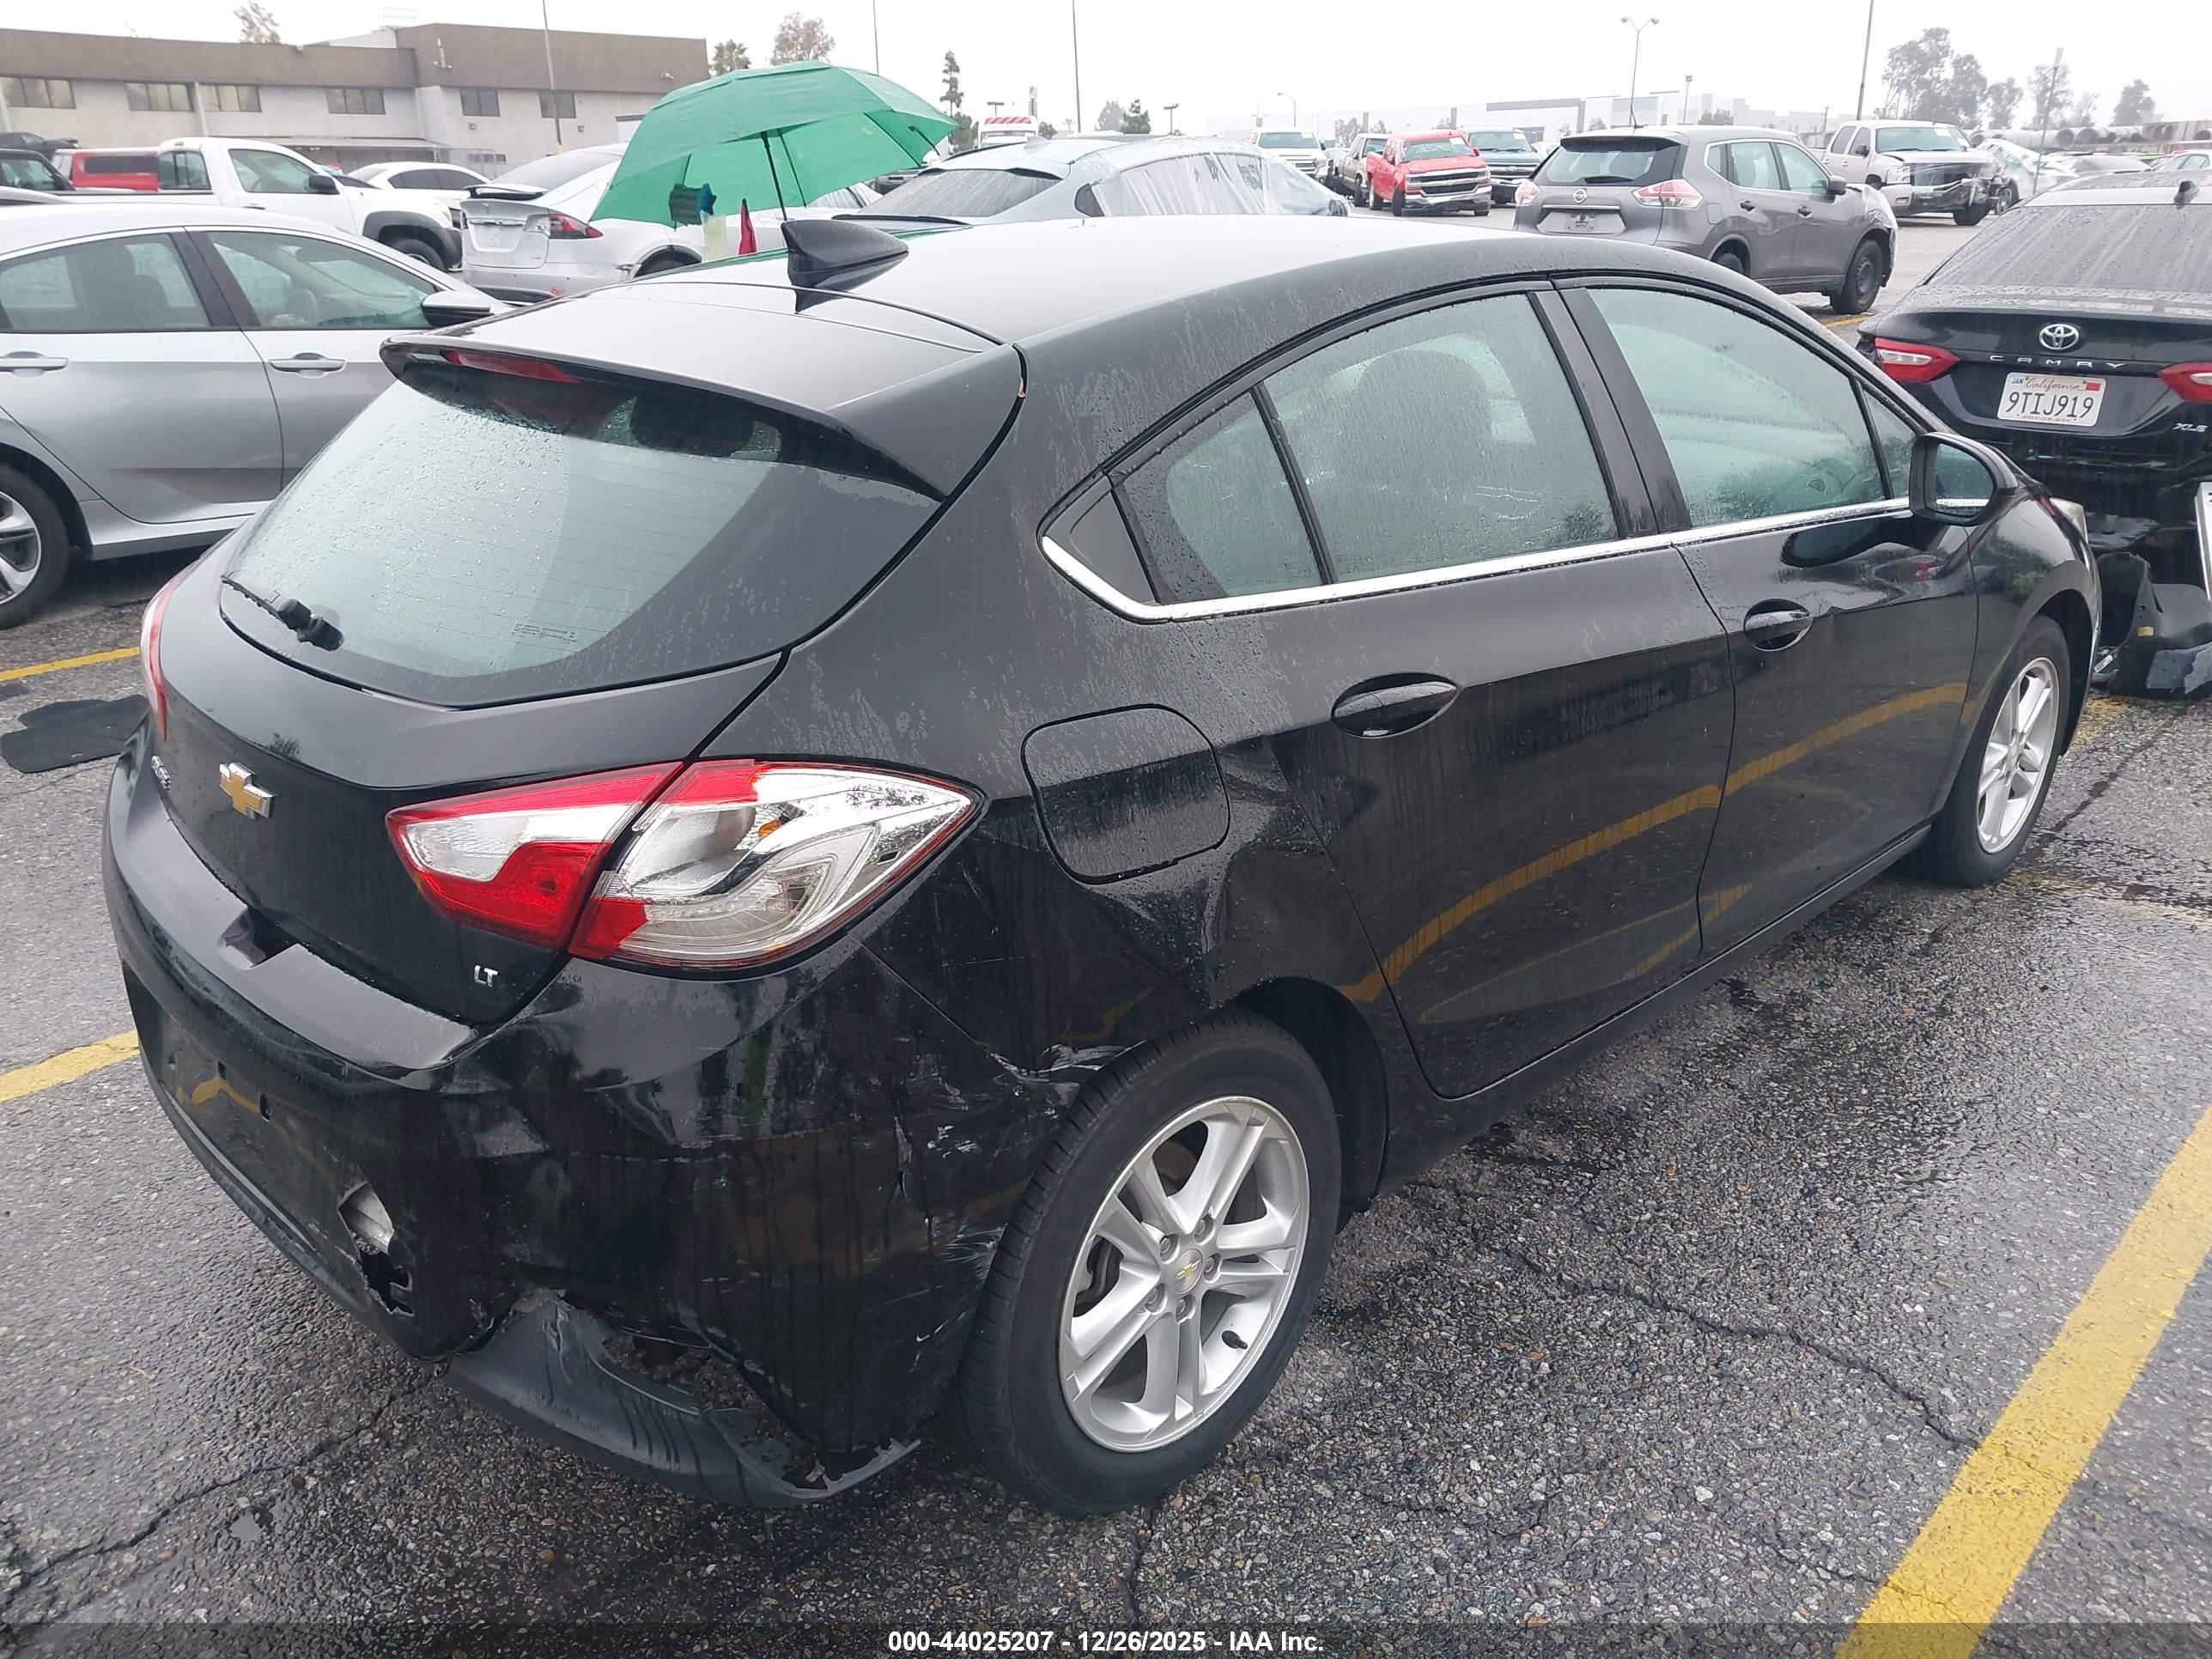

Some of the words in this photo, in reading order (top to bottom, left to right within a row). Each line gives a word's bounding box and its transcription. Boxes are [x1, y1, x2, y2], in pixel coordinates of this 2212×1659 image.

[1990, 355, 2125, 368] CAMRY
[2026, 377, 2081, 392] California
[2005, 392, 2094, 418] 9TIJ919
[2172, 422, 2209, 432] XLE
[474, 964, 498, 988] LT
